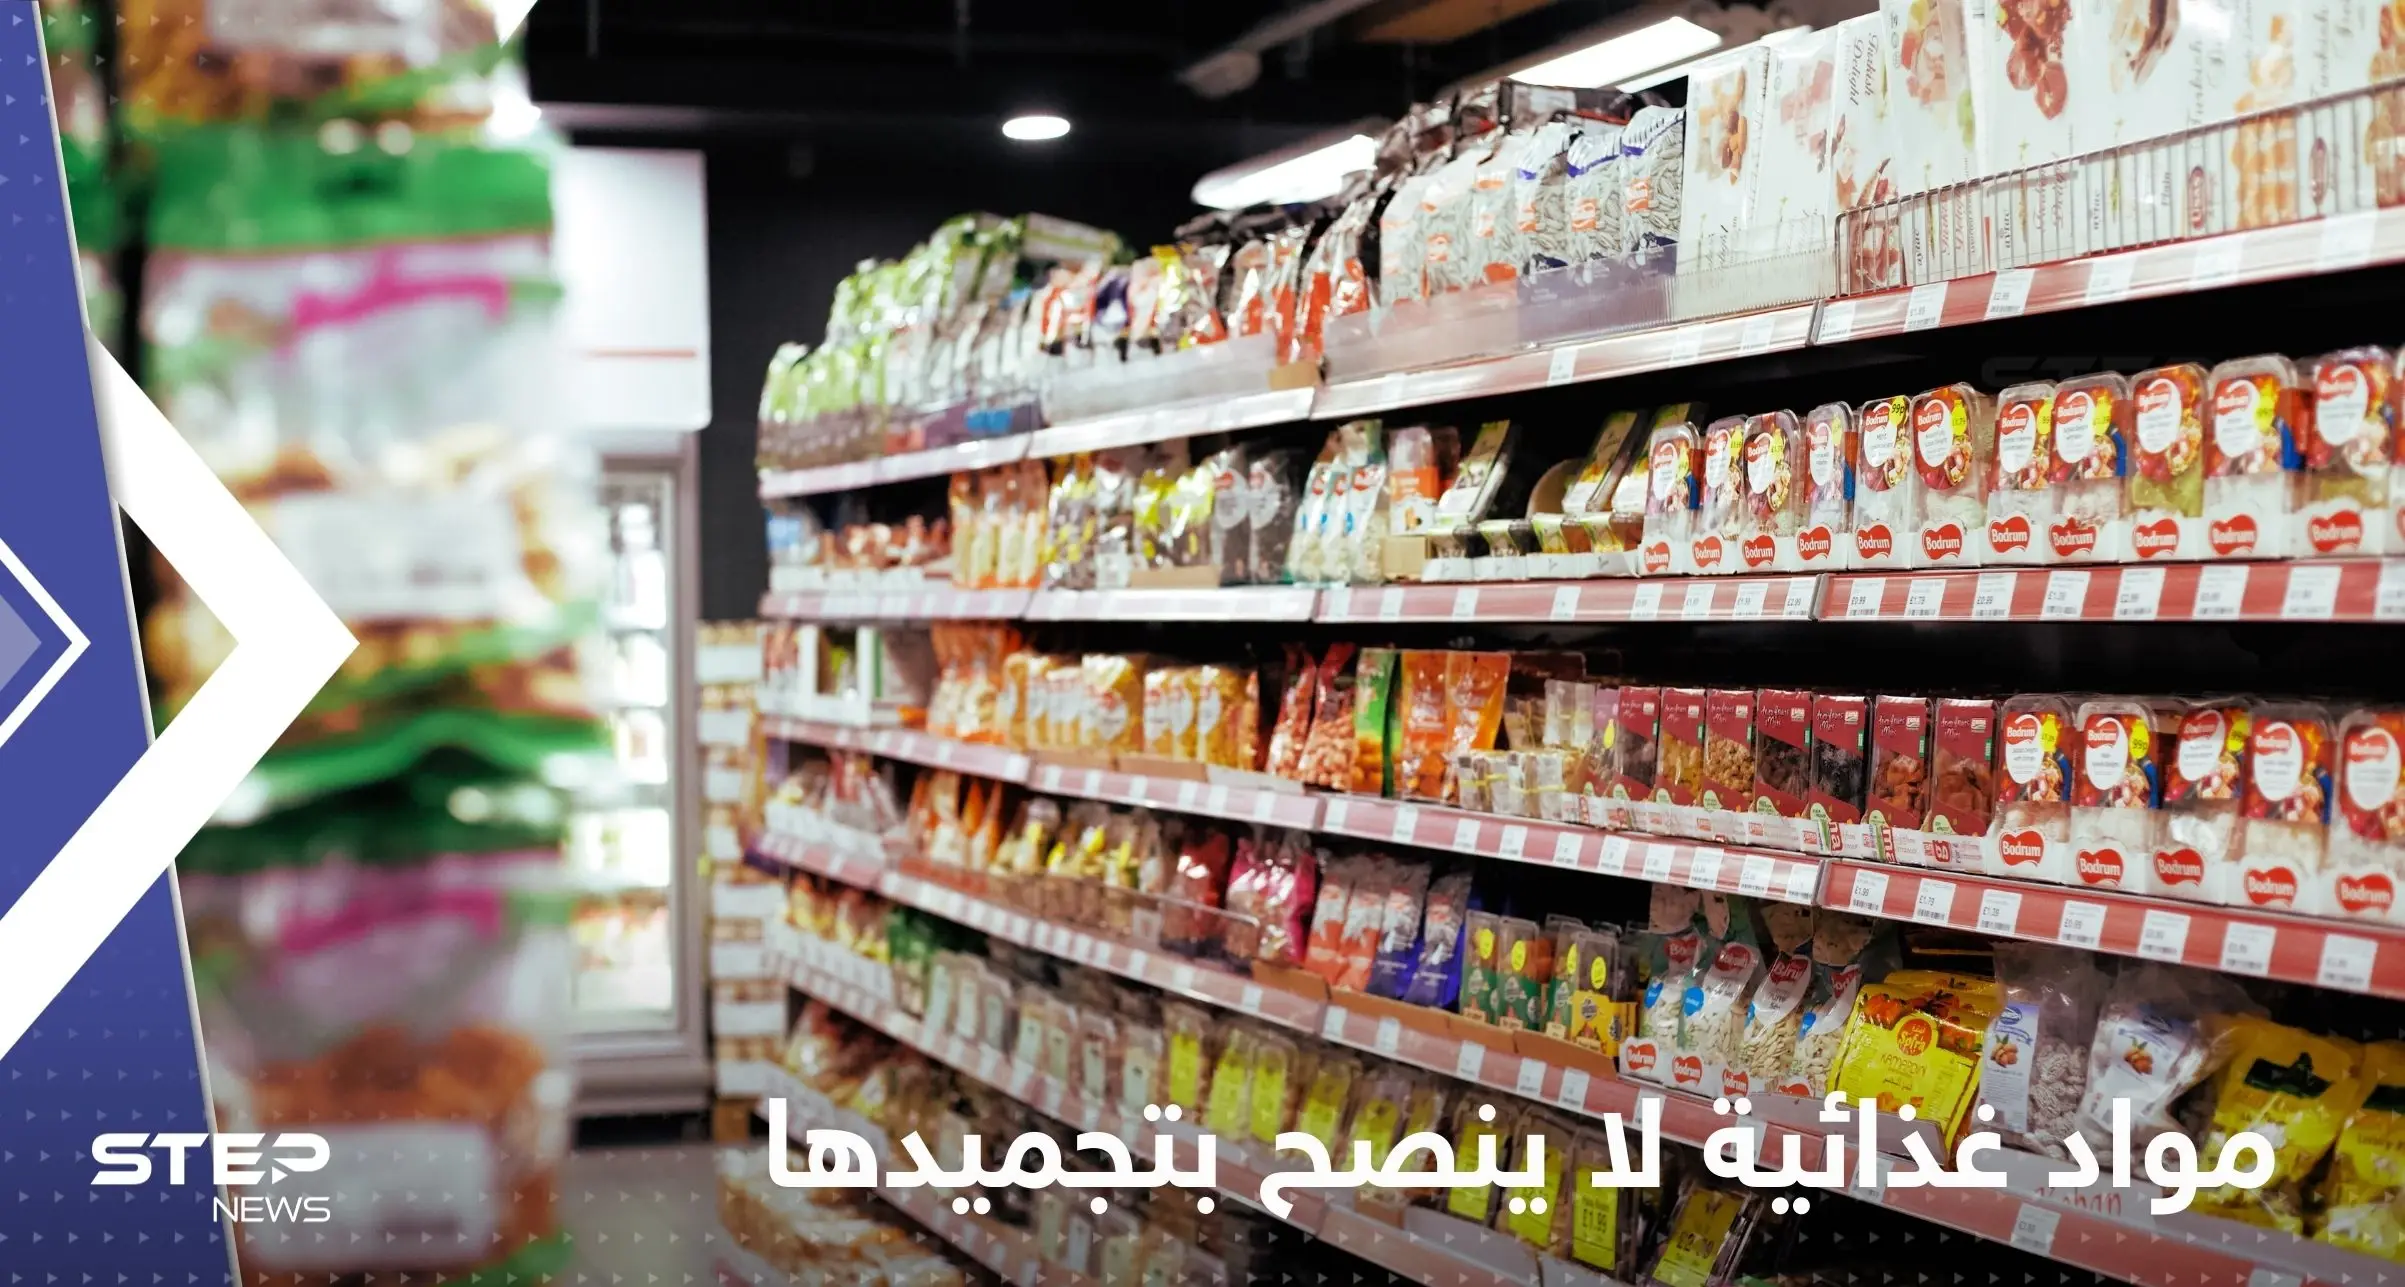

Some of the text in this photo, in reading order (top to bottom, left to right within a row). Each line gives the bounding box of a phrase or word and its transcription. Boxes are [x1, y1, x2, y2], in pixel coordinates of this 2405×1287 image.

[1866, 31, 1880, 98] Turkish
[1848, 38, 1866, 108] Delight
[1917, 412, 1942, 426] Bodrum
[1800, 538, 1829, 551] Bodrum
[1858, 535, 1891, 550] Bodrum
[1926, 535, 1961, 550] Bodrum
[1991, 530, 2028, 544] Bodrum
[2052, 531, 2094, 547] Bodrum
[2136, 531, 2177, 547] Bodrum
[1645, 551, 1669, 565] Bodrum
[1694, 546, 1721, 560] Bodrum
[1744, 546, 1774, 559] Bodrum
[2006, 726, 2036, 738] Bodrum
[2002, 839, 2041, 857] Bodrum
[2079, 857, 2121, 876] Bodrum
[2156, 858, 2201, 876] Bodrum
[1628, 1050, 1655, 1064] Bodrum
[1674, 1062, 1700, 1077] Bodrum
